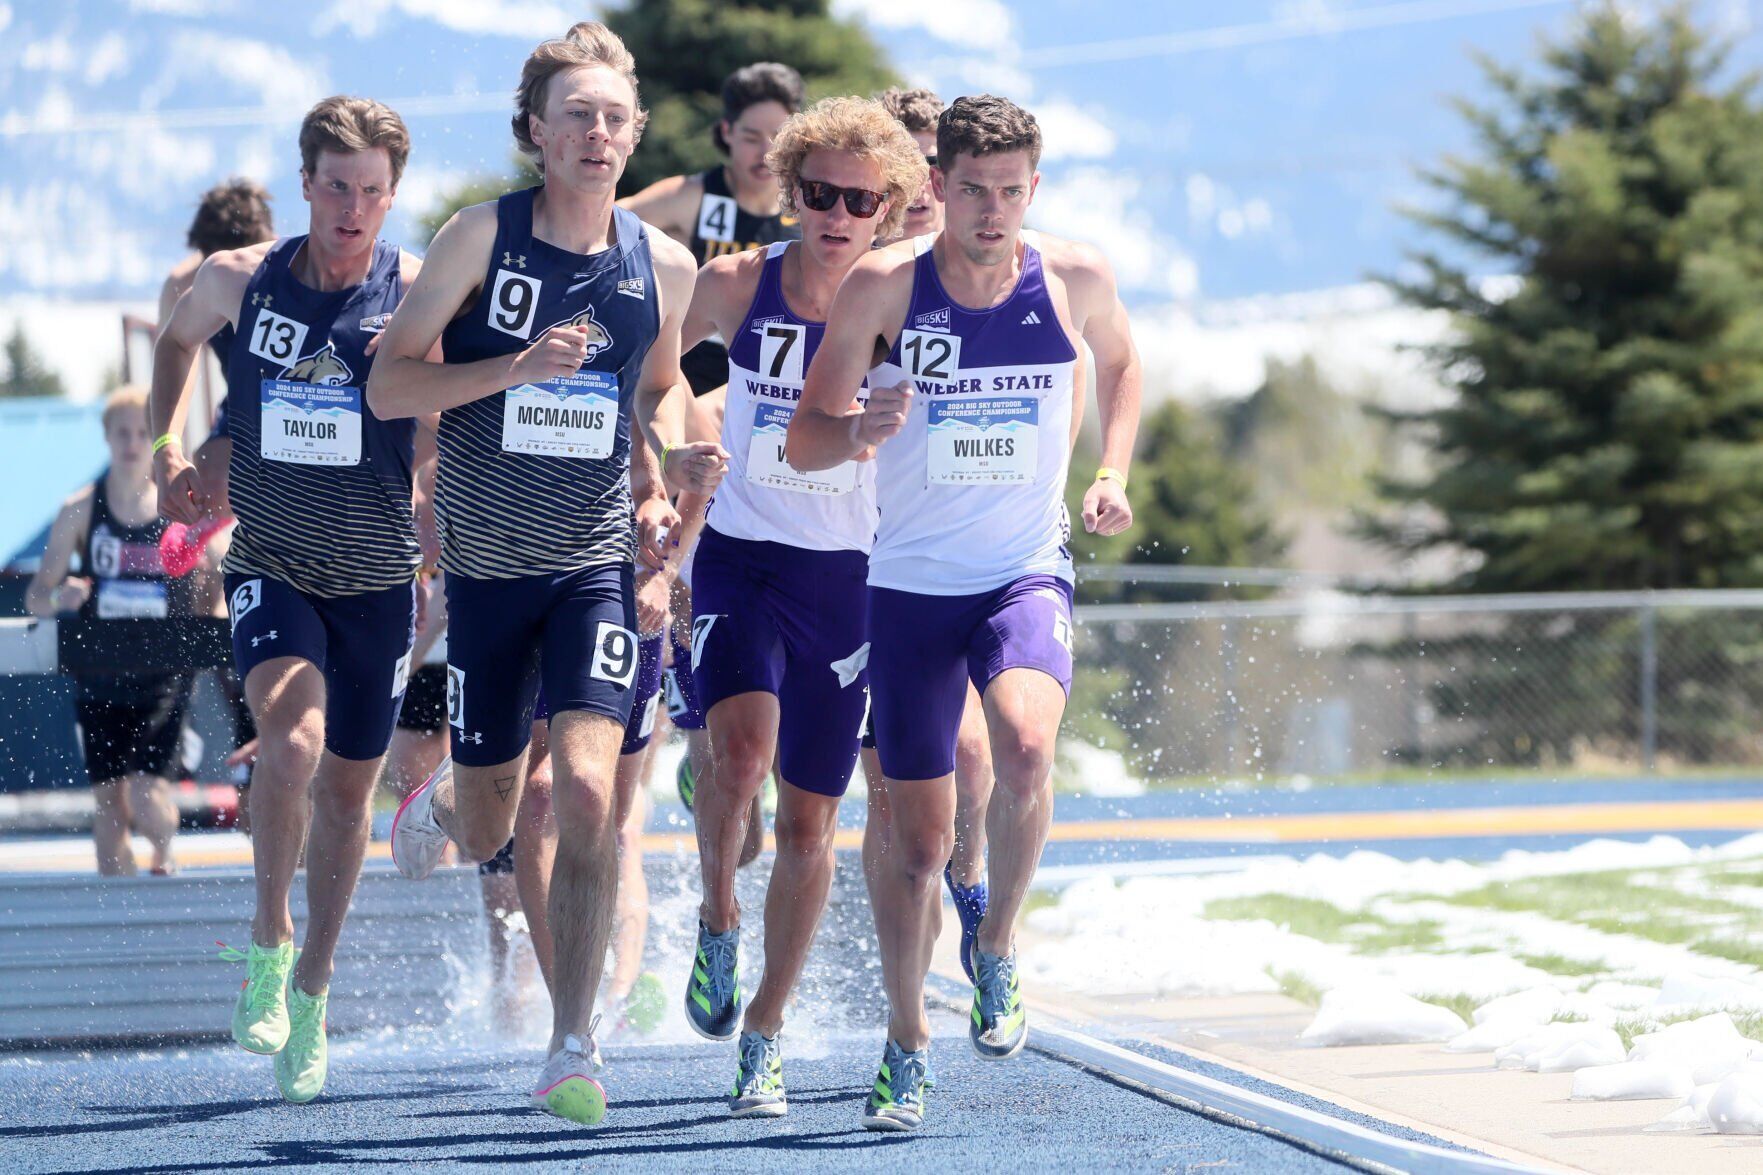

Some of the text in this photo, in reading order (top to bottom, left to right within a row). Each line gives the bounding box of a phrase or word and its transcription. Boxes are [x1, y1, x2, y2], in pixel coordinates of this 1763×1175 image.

[706, 203, 727, 236] 4
[496, 278, 533, 331] 9
[917, 309, 949, 324] BIGSKY
[258, 317, 296, 359] 13
[767, 327, 798, 378] 7
[905, 336, 952, 379] 12
[276, 384, 345, 396] 2024 BIG SKY OUTDOOR
[560, 379, 610, 389] CHAMPIONSHIP
[746, 379, 802, 401] WEBER
[915, 374, 1053, 396] WEBER STATE
[268, 389, 353, 403] CONFERENCE CHAMPIONSHIP
[979, 401, 991, 409] SKY
[517, 405, 605, 430] MCMANUS
[773, 409, 790, 418] 2024
[937, 407, 1031, 417] CONFERENCE CHAMPIONSHIP
[282, 419, 337, 440] TAYLOR
[954, 438, 1015, 458] WILKES
[600, 630, 634, 679] 9
